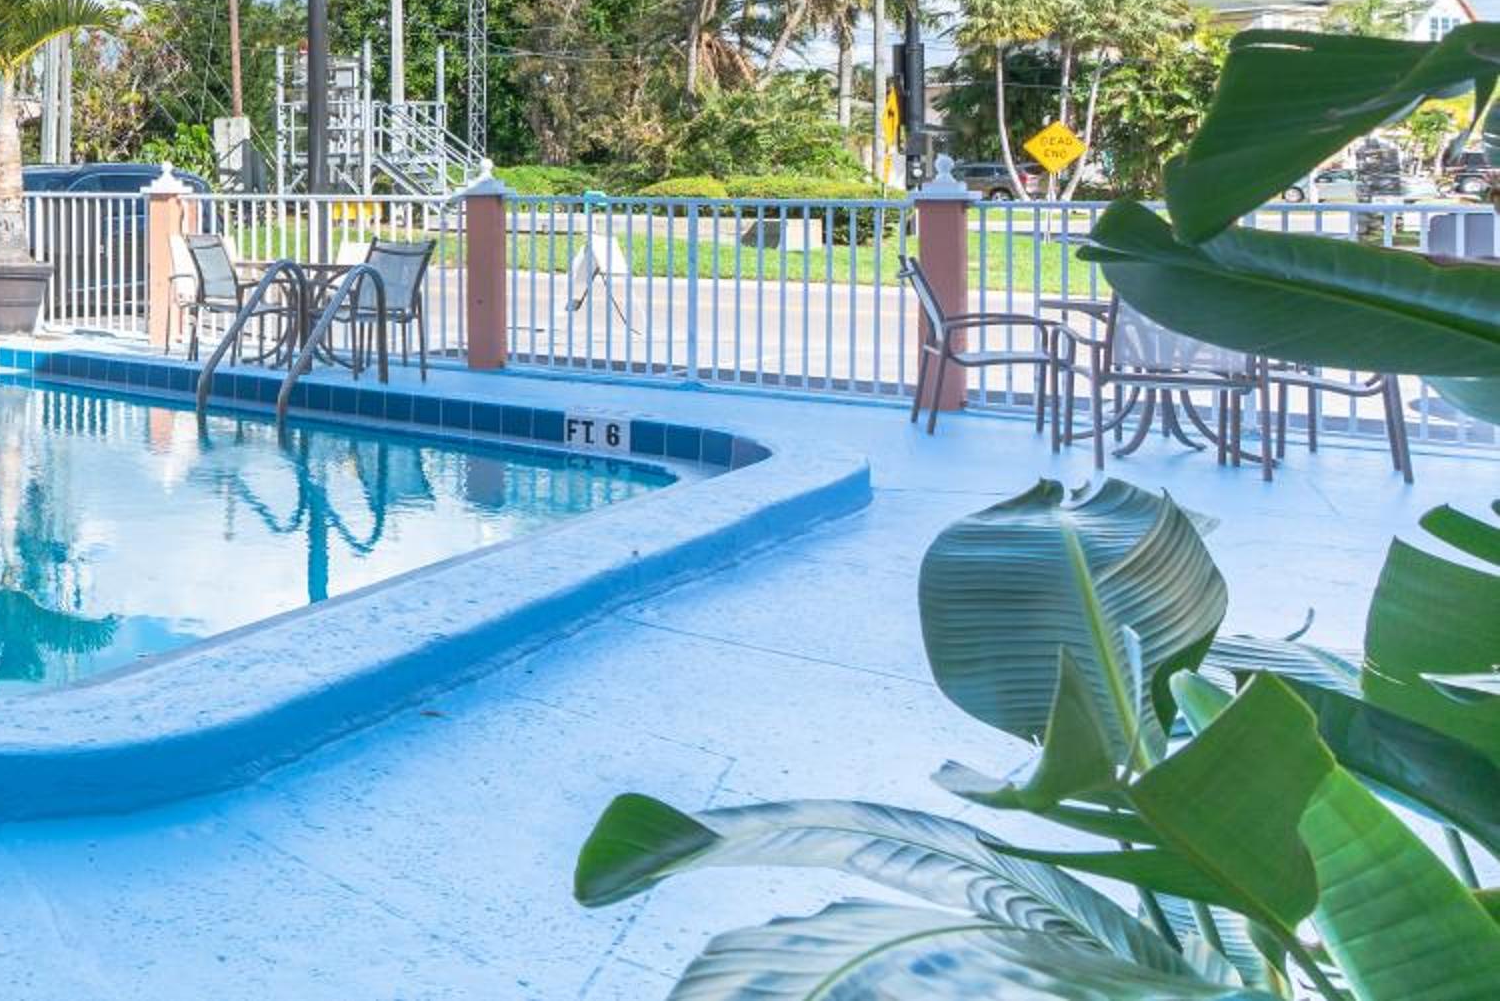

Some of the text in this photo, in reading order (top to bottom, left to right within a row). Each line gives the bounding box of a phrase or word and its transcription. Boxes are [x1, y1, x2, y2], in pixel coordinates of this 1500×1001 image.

[1041, 137, 1073, 146] DEAD
[1043, 149, 1068, 159] END
[567, 419, 620, 447] FT 6
